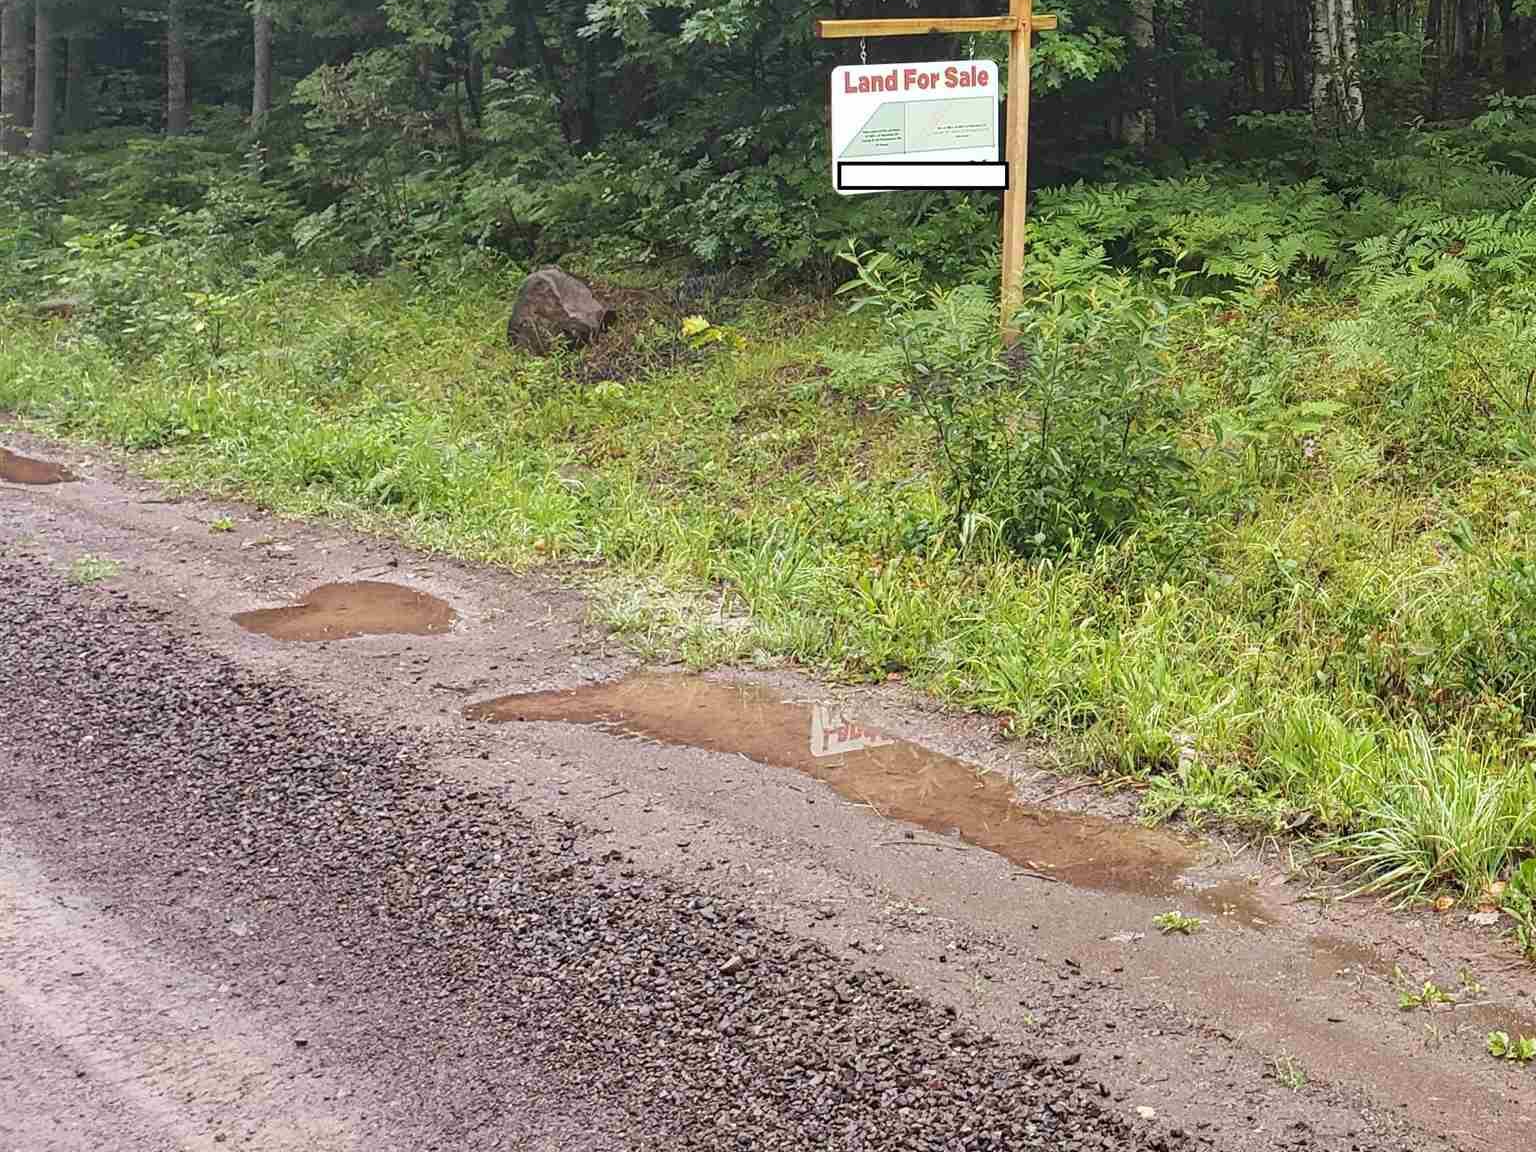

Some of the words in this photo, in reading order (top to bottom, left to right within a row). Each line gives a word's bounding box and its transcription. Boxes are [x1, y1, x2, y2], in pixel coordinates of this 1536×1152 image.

[845, 70, 898, 94] Land
[904, 69, 940, 90] For
[944, 66, 989, 88] Sale
